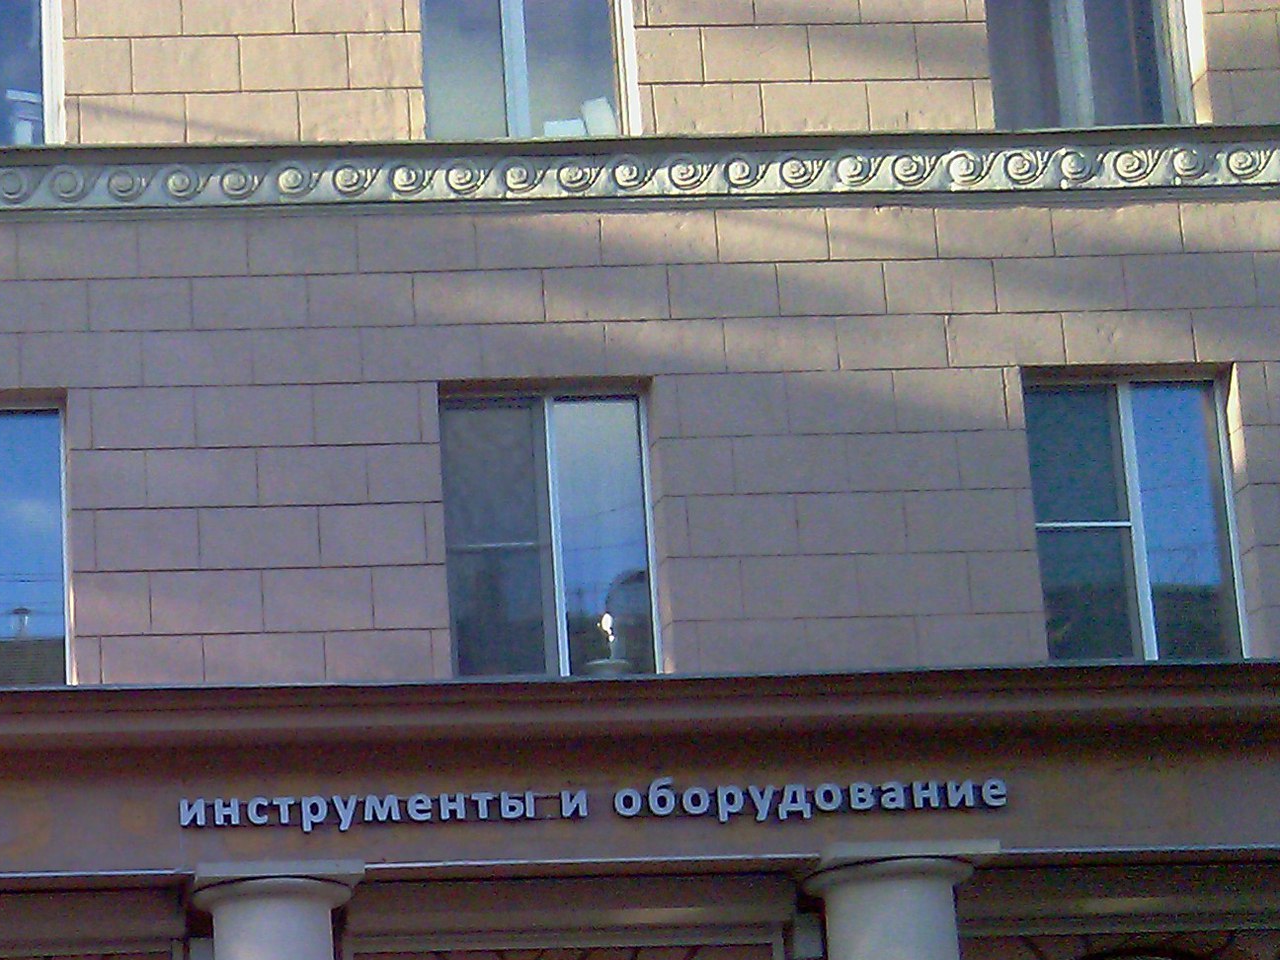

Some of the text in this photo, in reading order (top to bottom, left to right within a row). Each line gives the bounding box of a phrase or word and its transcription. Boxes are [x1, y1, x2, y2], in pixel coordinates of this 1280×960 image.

[178, 776, 1008, 831] инструменты и оборудование
